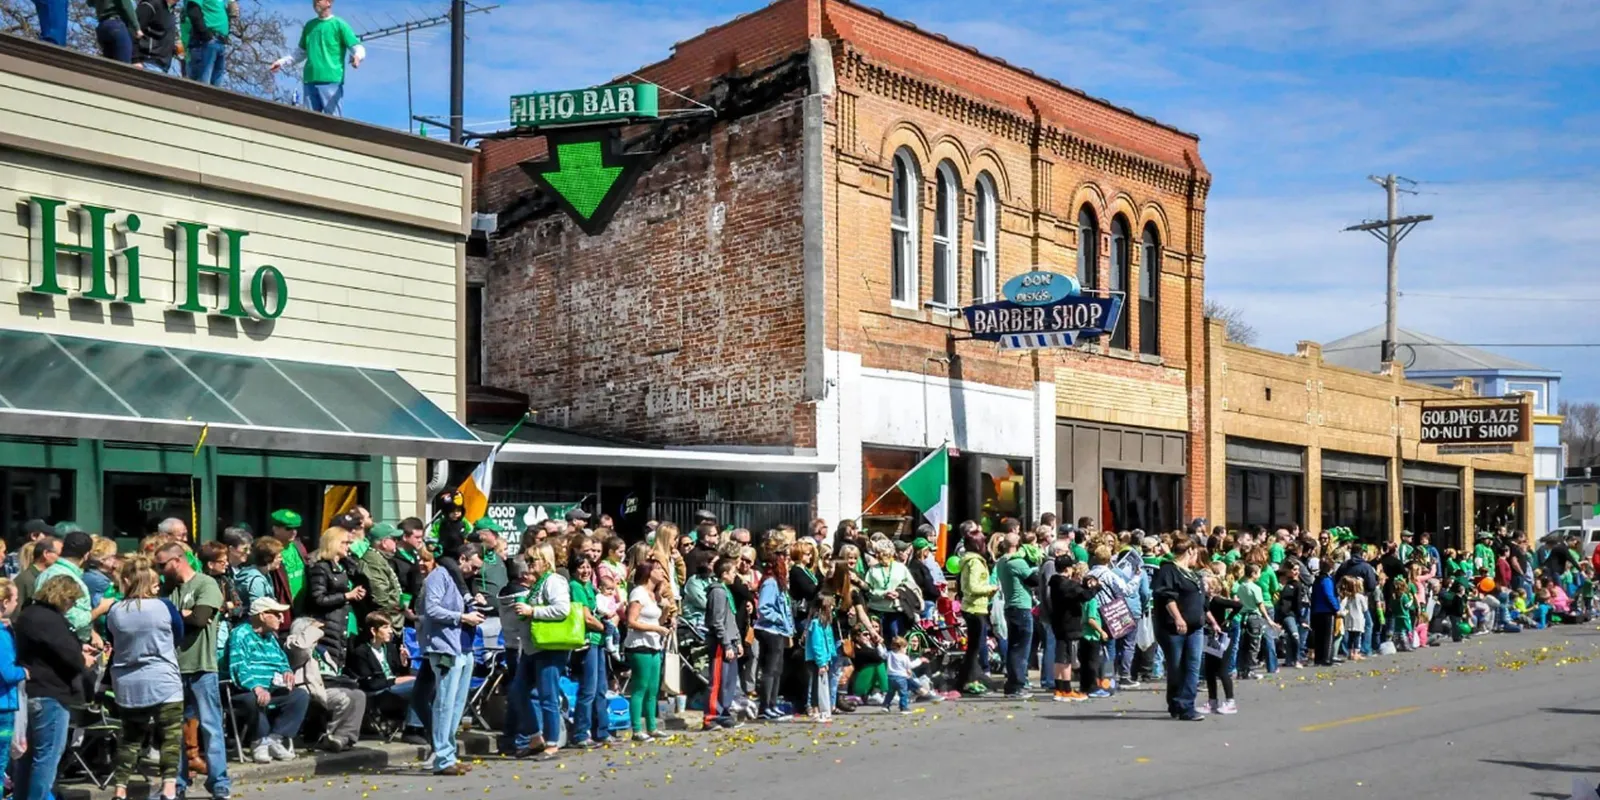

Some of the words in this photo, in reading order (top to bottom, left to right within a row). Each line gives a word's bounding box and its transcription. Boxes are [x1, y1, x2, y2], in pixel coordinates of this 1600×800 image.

[583, 87, 635, 116] BAR
[30, 196, 145, 304] Hi
[176, 222, 288, 319] Ho
[974, 307, 1045, 334] BARBER
[1051, 303, 1103, 330] SHOP
[1479, 424, 1519, 439] SHOP
[488, 506, 516, 518] GOOD
